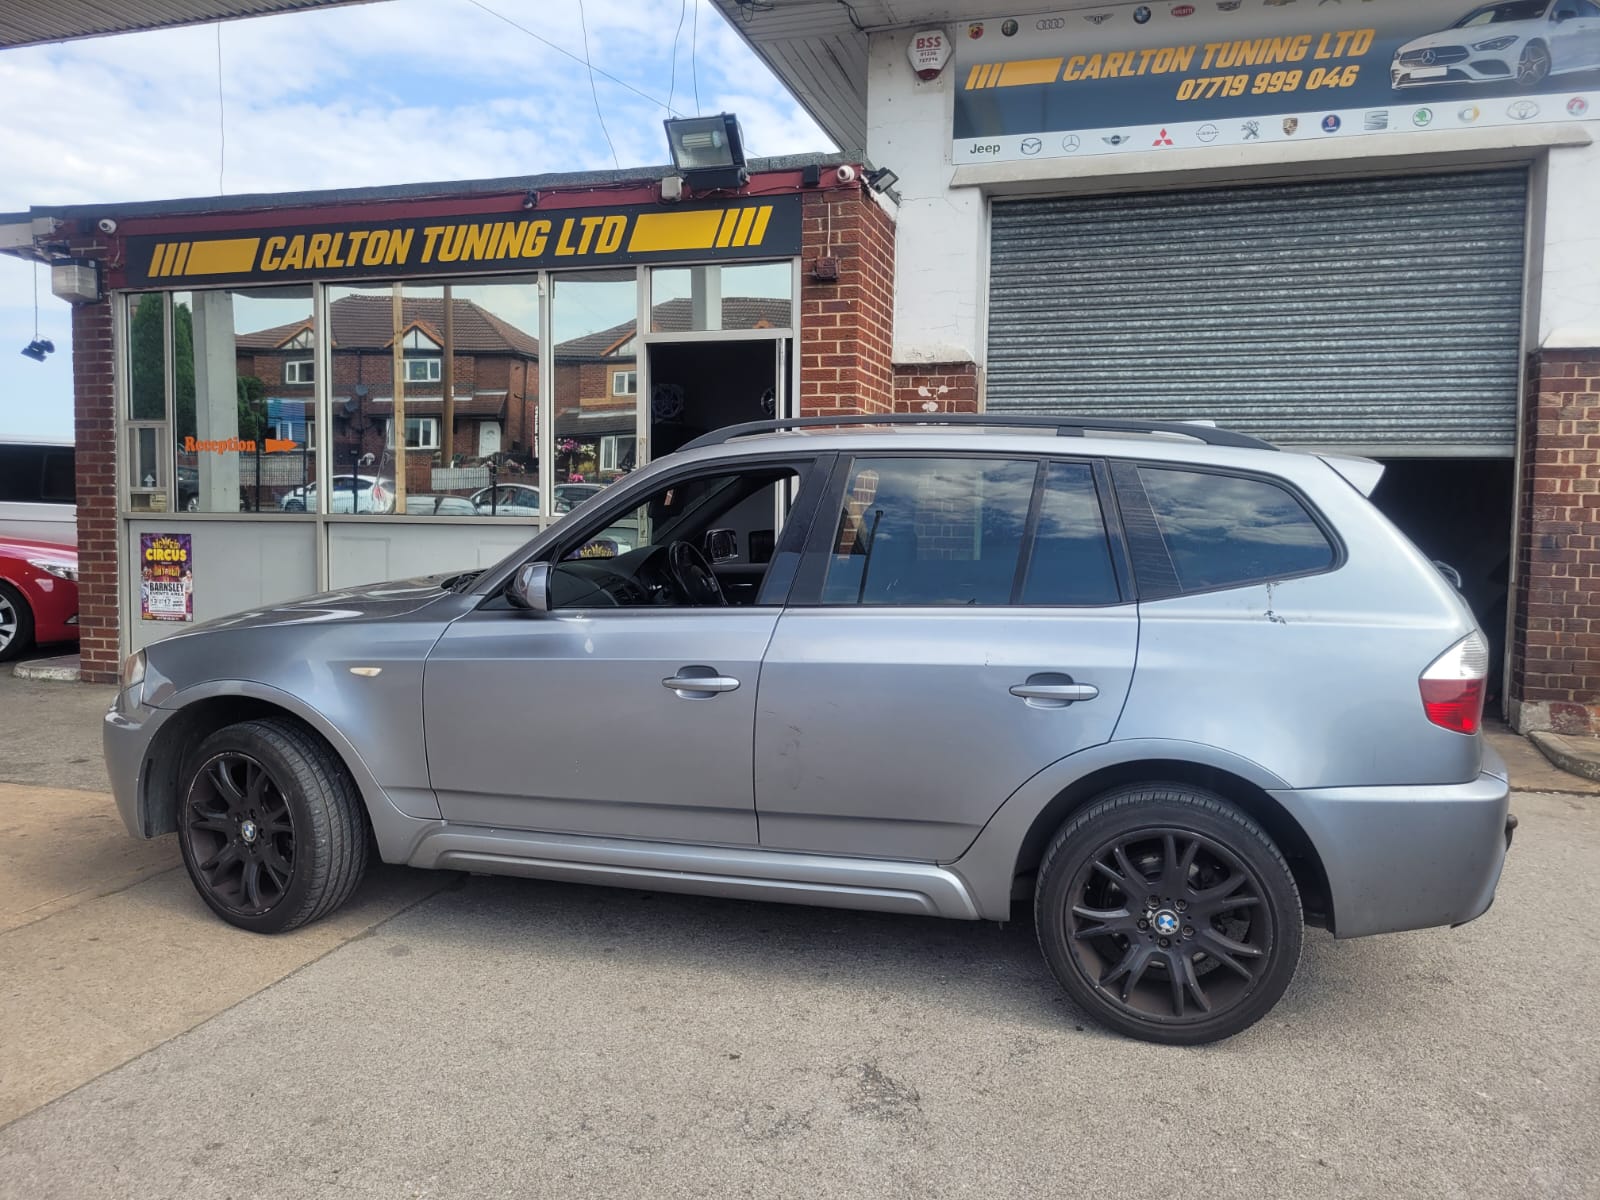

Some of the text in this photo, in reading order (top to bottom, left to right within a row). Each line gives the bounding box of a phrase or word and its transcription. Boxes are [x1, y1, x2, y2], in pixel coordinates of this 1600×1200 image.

[1062, 29, 1376, 81] CARLTON TUNING LTD
[1176, 65, 1361, 101] 07719 999 046
[970, 143, 1001, 156] Jeep
[260, 215, 628, 272] CARLTON TUNING LTD
[184, 436, 256, 455] Reception
[145, 548, 187, 561] CIRCUS
[149, 582, 184, 592] BARNSLEY
